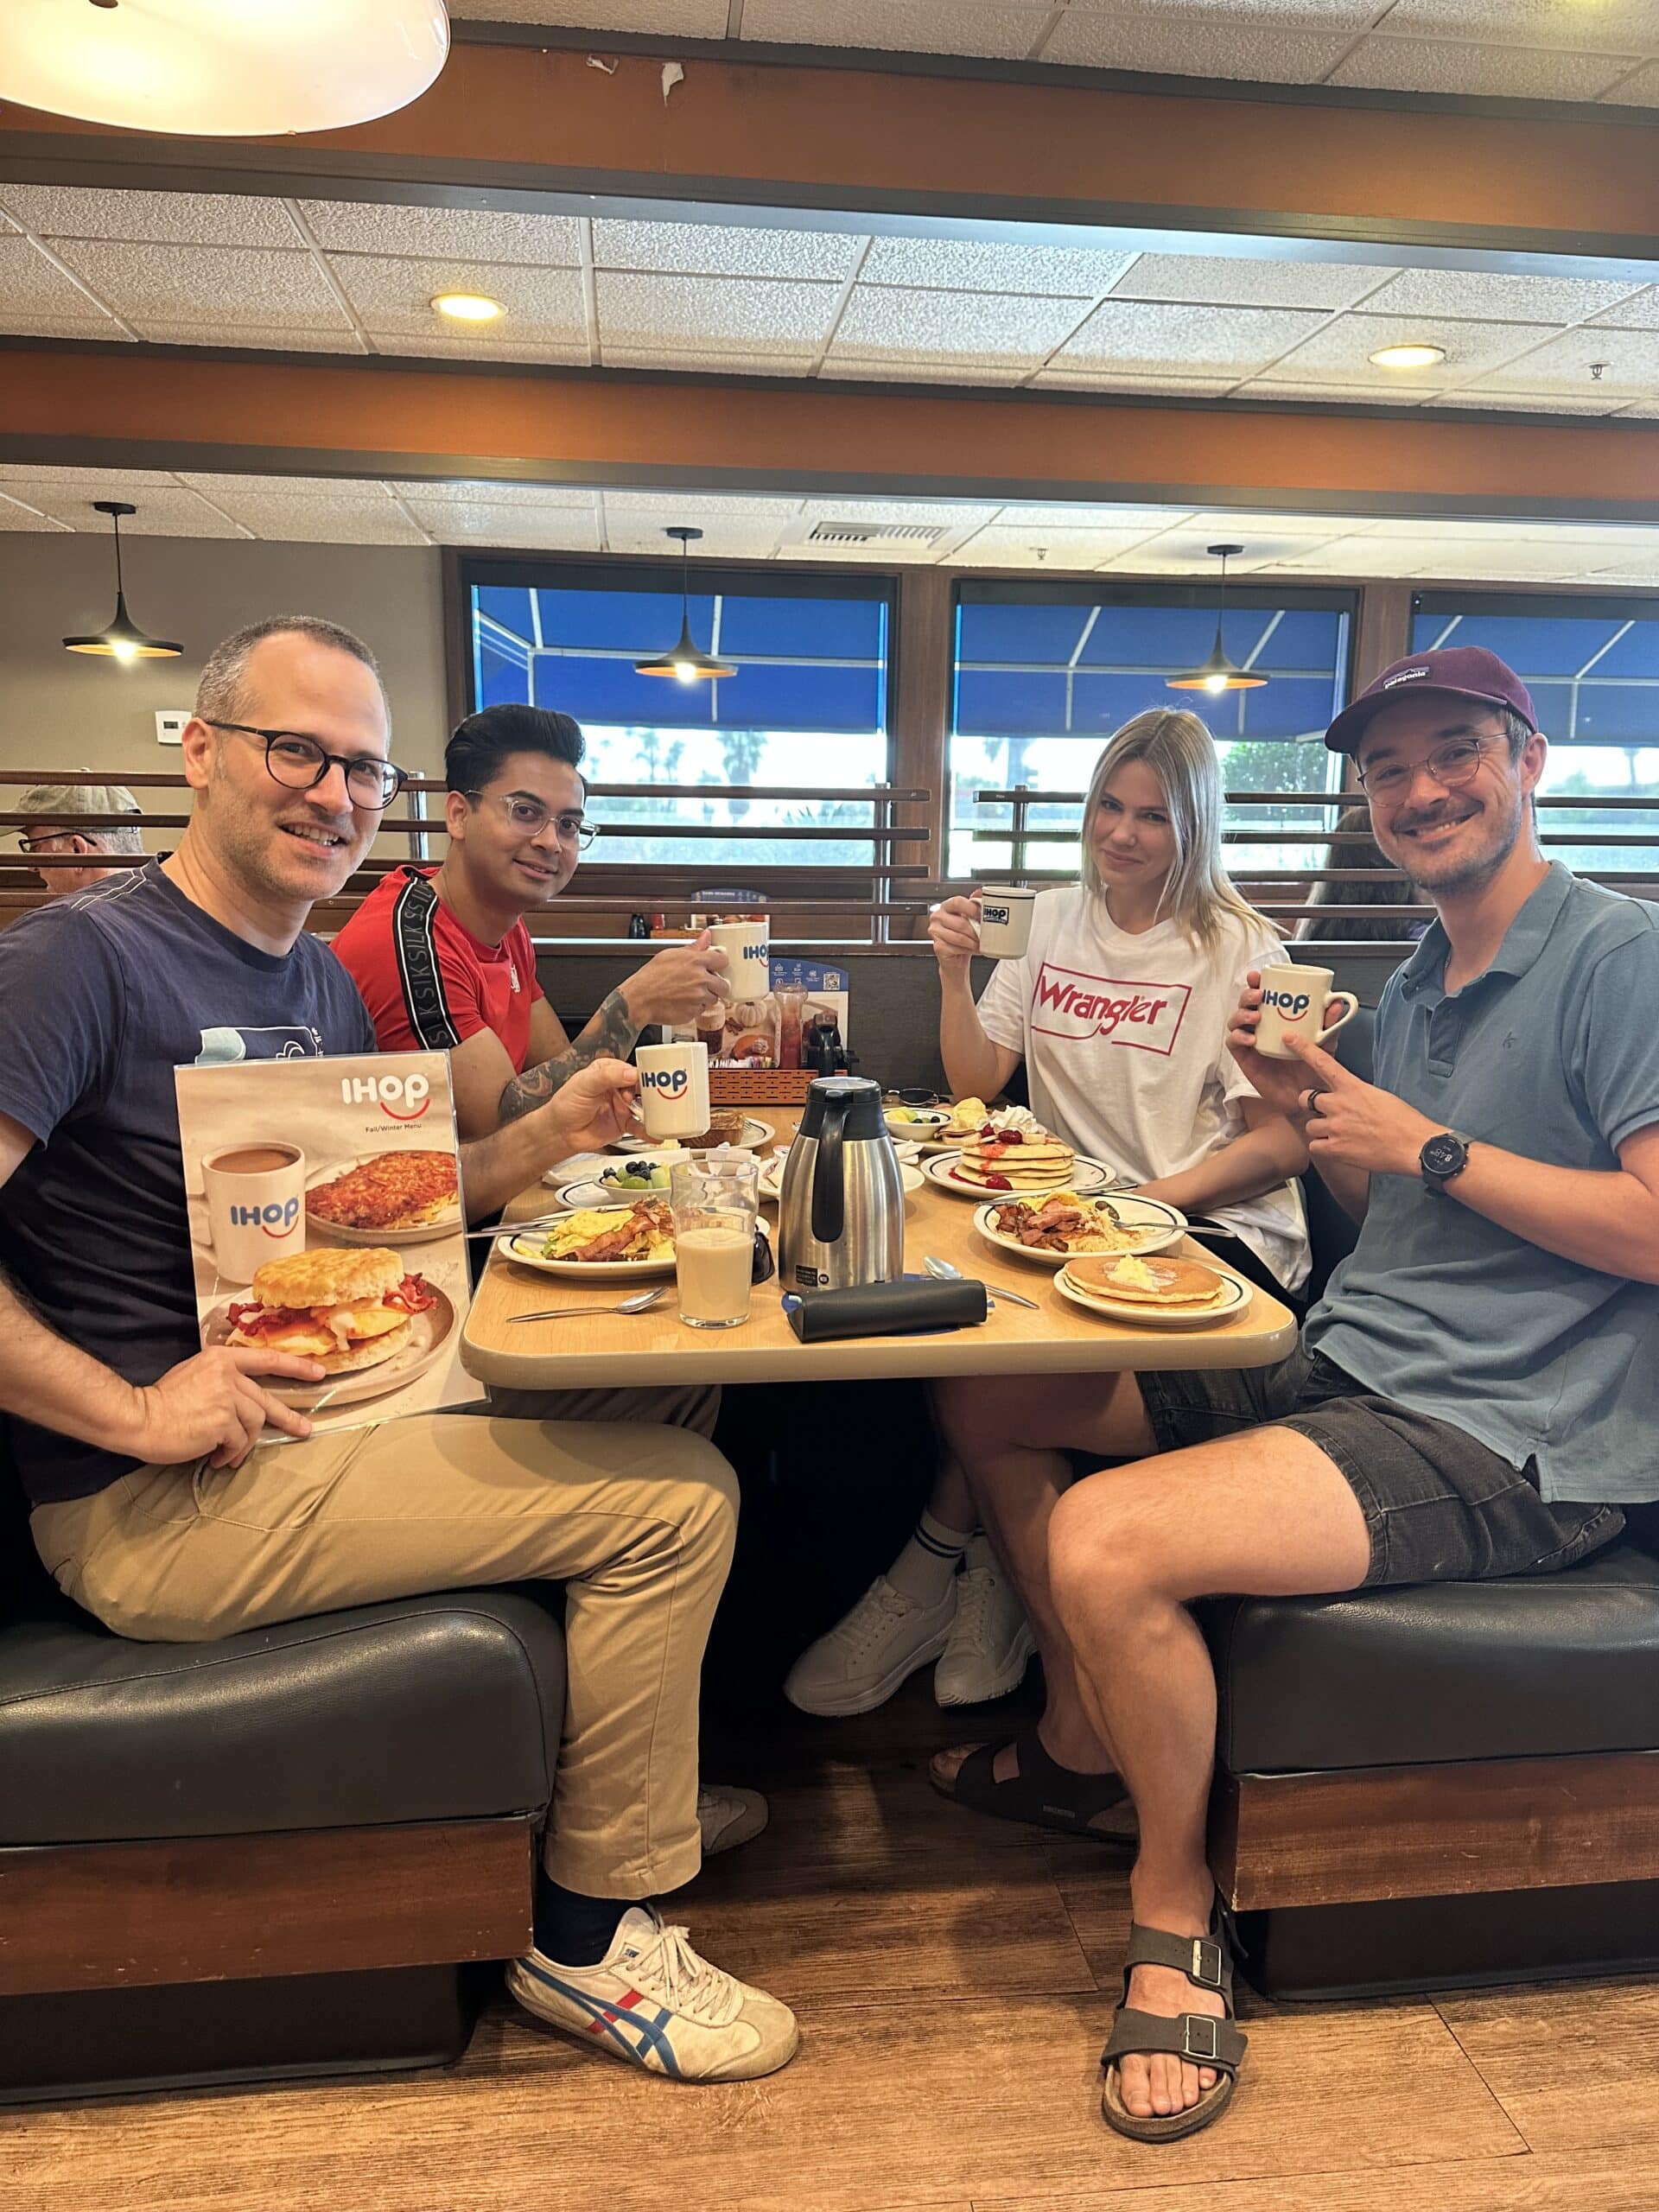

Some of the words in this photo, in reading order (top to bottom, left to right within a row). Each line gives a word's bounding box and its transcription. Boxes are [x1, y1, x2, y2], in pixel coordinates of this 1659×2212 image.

[743, 944, 769, 961] IHO
[1039, 975, 1168, 1035] Wrangler
[1262, 988, 1310, 1014] IHOP
[341, 1074, 429, 1108] IHOP
[641, 1070, 687, 1091] IHOP
[230, 1197, 299, 1227] IHOP
